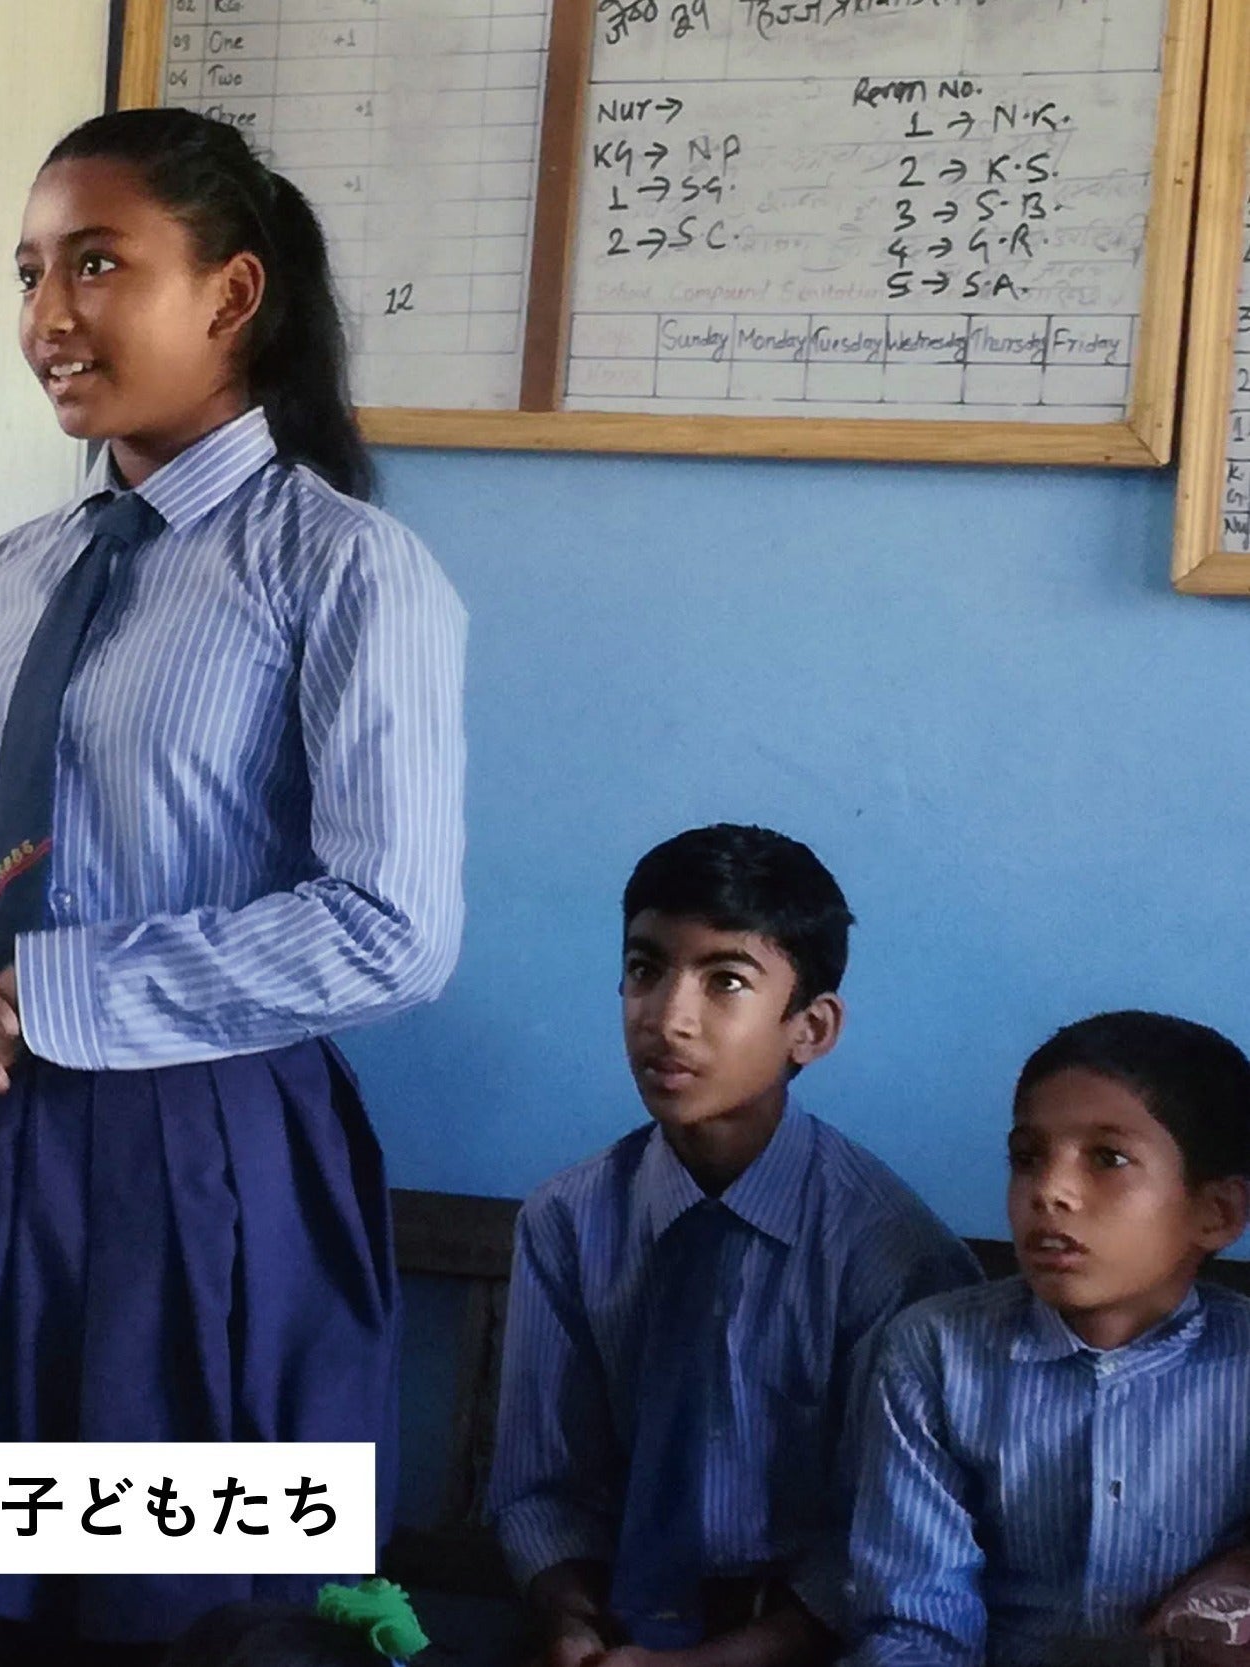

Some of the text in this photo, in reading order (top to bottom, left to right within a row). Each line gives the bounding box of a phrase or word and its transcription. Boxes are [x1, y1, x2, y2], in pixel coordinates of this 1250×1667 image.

[209, 31, 245, 53] One
[208, 64, 243, 86] Two
[898, 156, 926, 187] 2
[893, 199, 917, 232] 3
[607, 228, 631, 256] 2
[887, 237, 909, 270] 4
[384, 282, 415, 316] 12
[886, 271, 914, 299] 5
[661, 318, 730, 363] Sunday
[738, 326, 808, 362] Monday
[808, 325, 883, 363] Tuesday
[1053, 327, 1121, 365] Friday
